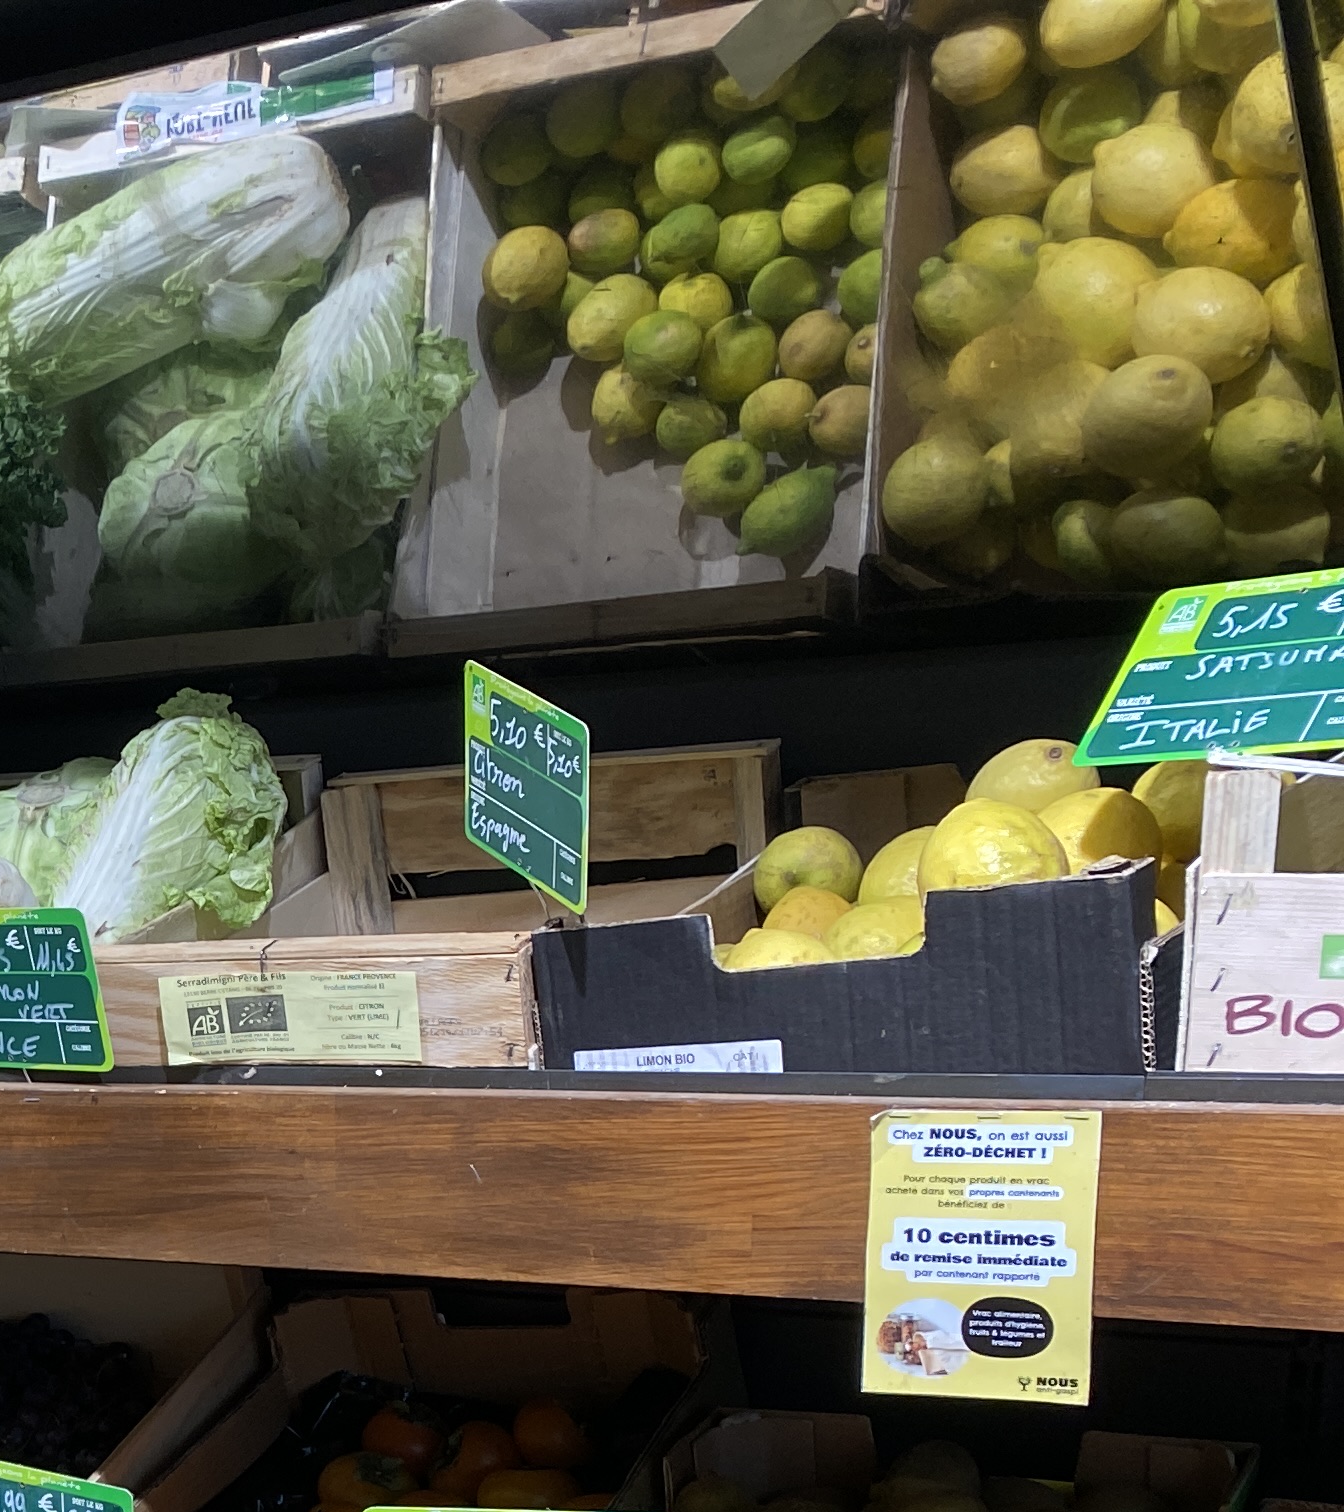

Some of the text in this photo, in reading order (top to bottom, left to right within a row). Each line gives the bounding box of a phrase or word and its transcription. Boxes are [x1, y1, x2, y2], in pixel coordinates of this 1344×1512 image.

[1212, 602, 1298, 638] 5,15
[1119, 708, 1271, 750] ITALIE
[474, 748, 525, 798] Citron
[18, 1002, 73, 1021] VERT
[1224, 996, 1344, 1037] BIO
[637, 1053, 695, 1066] LIMON BIO
[893, 1128, 1068, 1142] Chez NOUS, on est aussi
[924, 1144, 1036, 1159] ZÉRO-DÉCHET
[903, 1175, 925, 1183] Pour
[929, 1176, 966, 1186] chaque
[969, 1175, 1007, 1186] produit
[921, 1187, 1060, 1199] dans propres contenants
[903, 1228, 1056, 1248] 10 centimes
[890, 1251, 1068, 1268] de remise immédiate
[914, 1270, 1040, 1283] par contenant rapporté
[1036, 1377, 1079, 1388] NOUS
